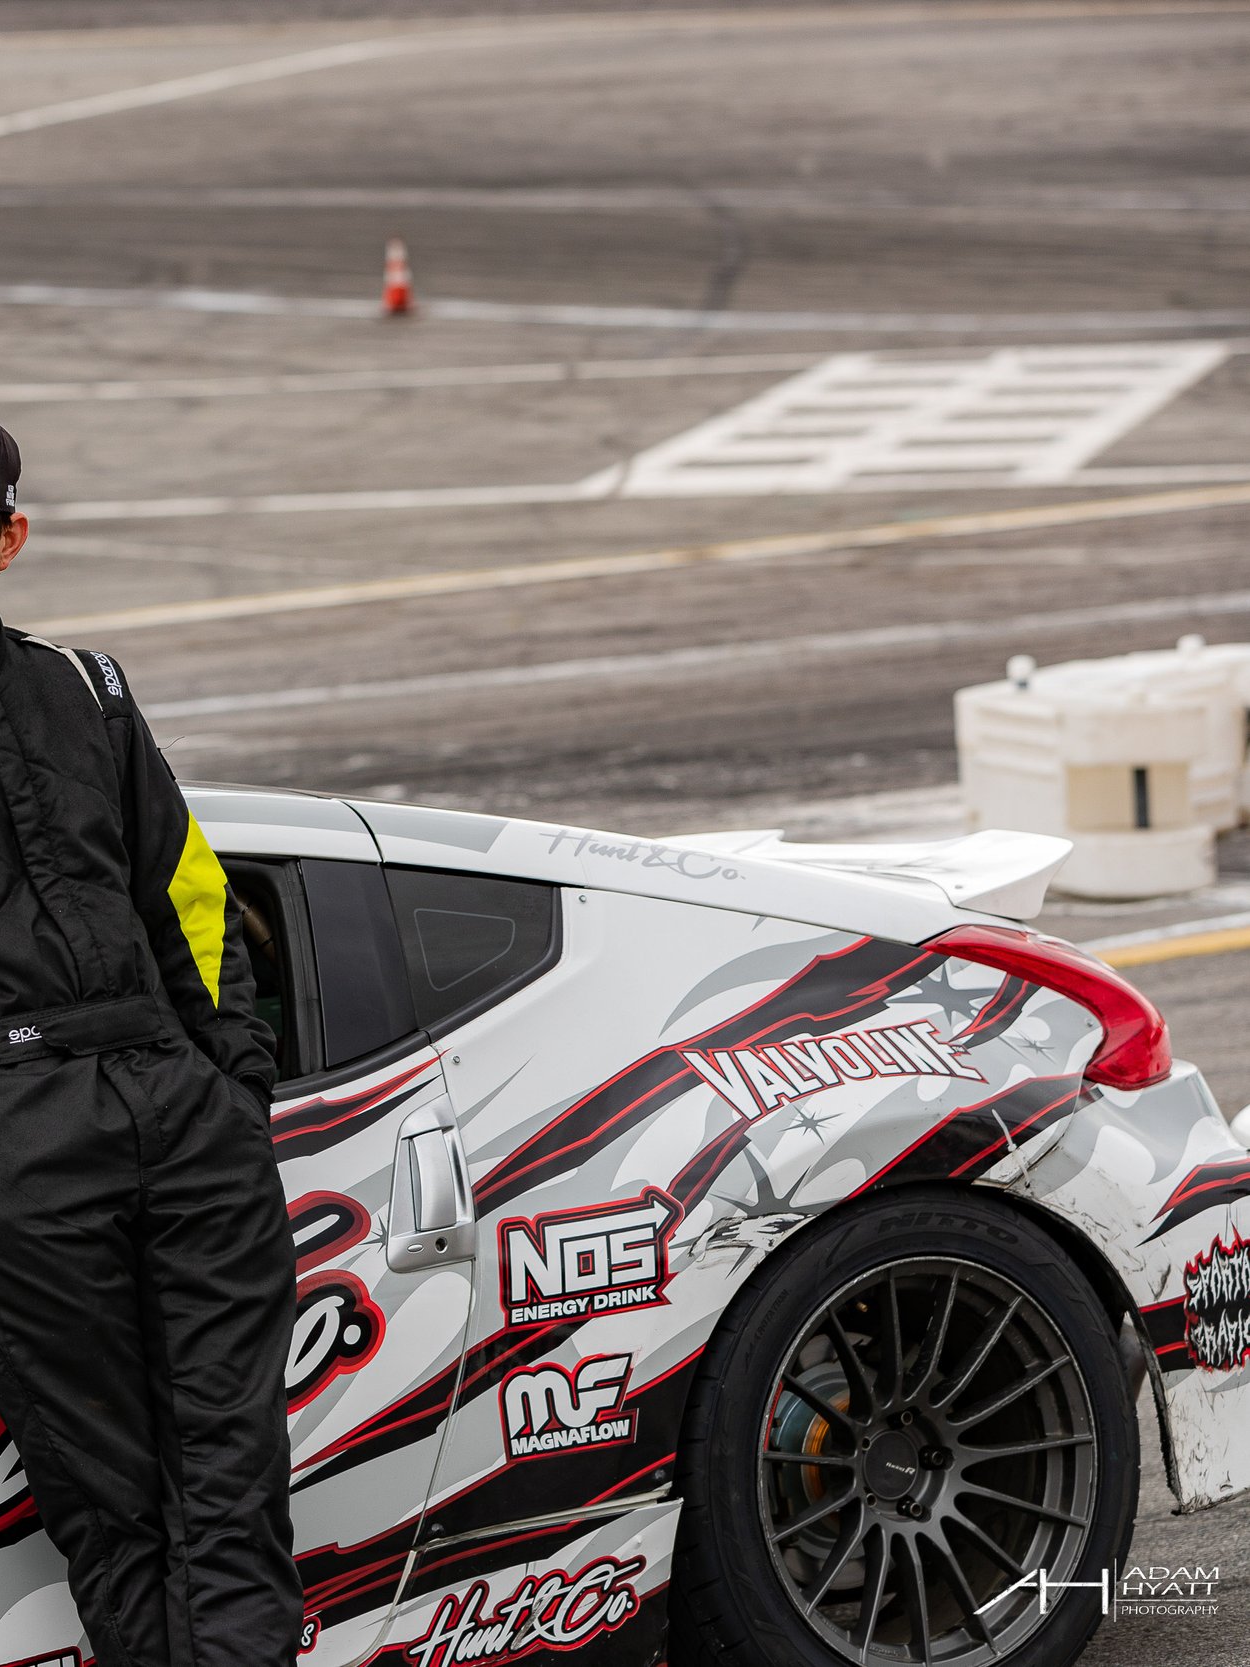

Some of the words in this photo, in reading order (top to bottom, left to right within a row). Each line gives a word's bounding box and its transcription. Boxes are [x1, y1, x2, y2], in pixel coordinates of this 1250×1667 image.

[89, 651, 123, 698] sparco
[681, 1020, 984, 1120] VALVOLINE
[878, 1211, 1019, 1245] NITTO
[508, 1200, 672, 1302] NOS
[511, 1298, 591, 1324] ENERGY
[594, 1284, 657, 1312] DRINK
[511, 1417, 630, 1457] MAGNAFLOW
